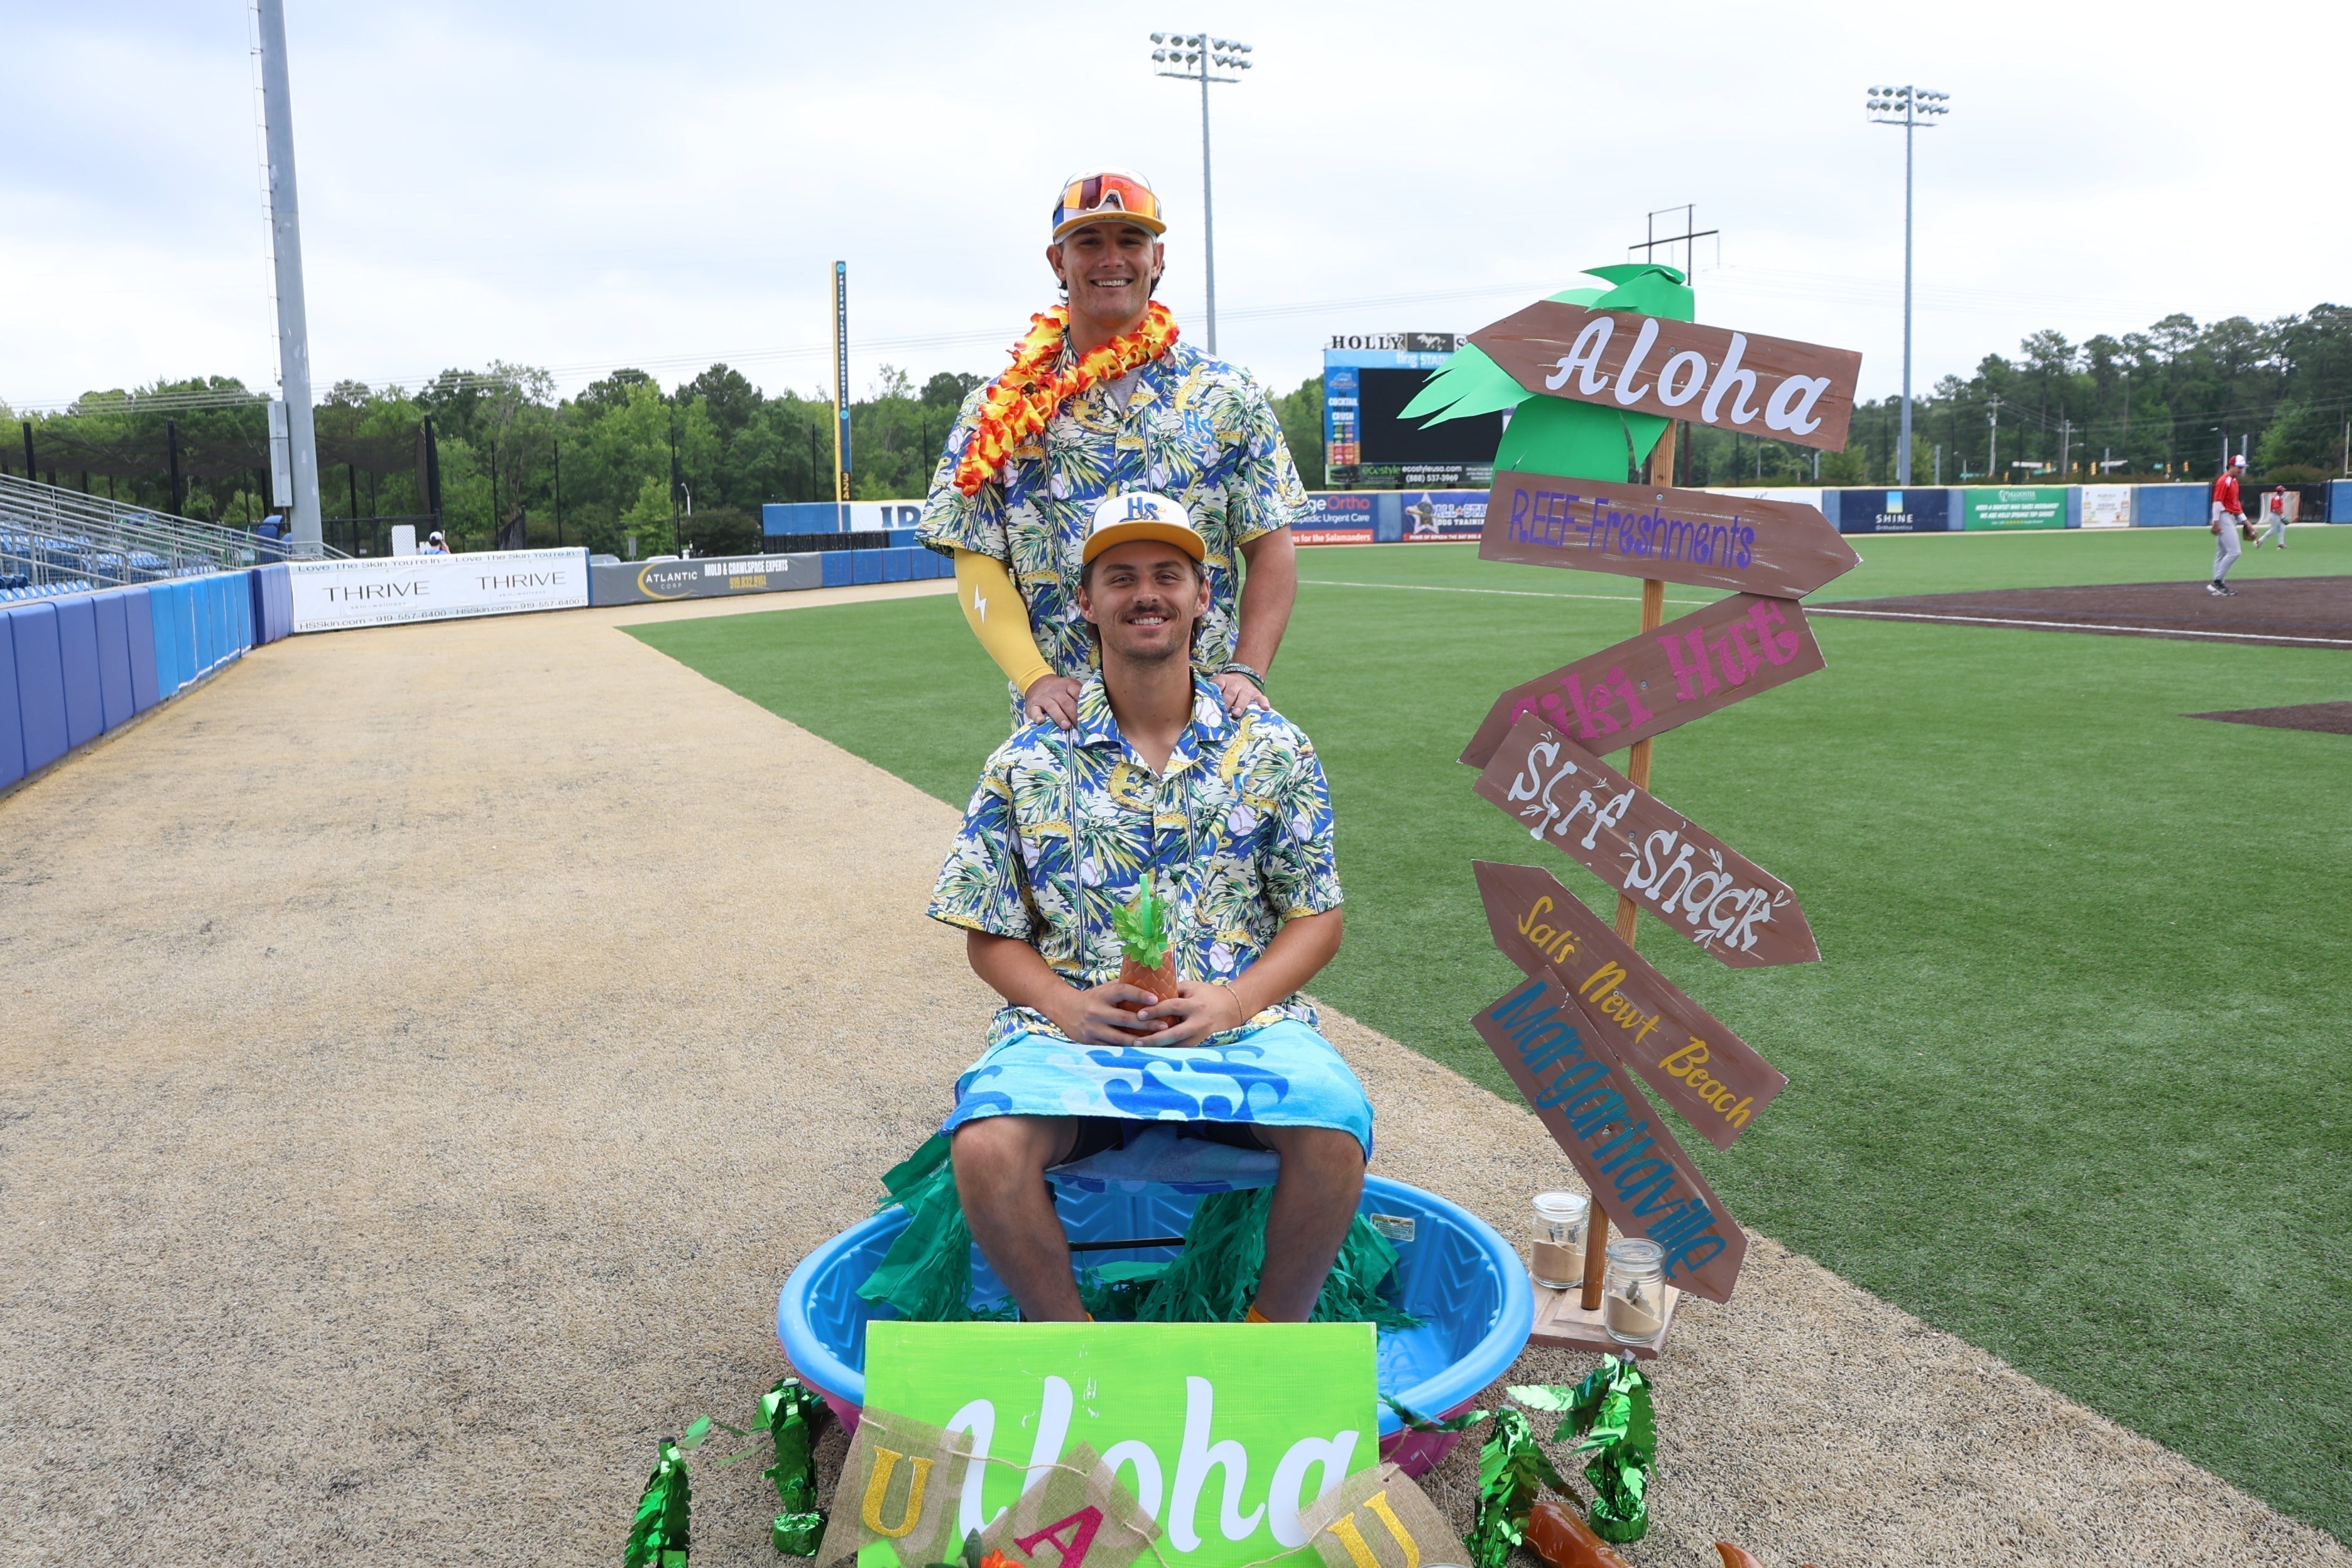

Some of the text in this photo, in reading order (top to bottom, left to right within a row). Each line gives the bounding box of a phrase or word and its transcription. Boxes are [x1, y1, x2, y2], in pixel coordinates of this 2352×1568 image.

[1331, 335, 1403, 349] HOLLY
[1396, 351, 1417, 368] ting
[1545, 316, 1832, 436] Aloha
[1328, 397, 1359, 406] COCKTAIL
[1332, 411, 1354, 421] CRUSH
[1402, 465, 1462, 474] ecostyleusa.com
[1405, 474, 1426, 483] (888)
[842, 472, 851, 500] 324
[1307, 495, 1370, 514] geOrtho
[880, 505, 922, 528] ID
[1322, 513, 1350, 525] Urgent
[1351, 513, 1370, 523] Care
[1875, 513, 1914, 524] SHINE
[1508, 487, 1755, 569] REEF-Freshments
[1300, 533, 1312, 543] for
[1312, 533, 1324, 543] the
[1325, 533, 1371, 543] Salamanders
[361, 560, 388, 569] Skin
[704, 558, 788, 577] MOLD & CRAWLSPACE EXPERTS
[475, 571, 566, 591] THRIVE
[646, 571, 698, 583] ATLANTIC
[322, 580, 430, 602] THRIVE
[300, 598, 580, 630] HSSkin.com 919-557-6400 HSSkin.com 919-557-6400
[1655, 599, 1800, 703] Hut
[1623, 829, 1772, 952] Shack
[1518, 895, 1755, 1130] Sal's Newt Beach
[1489, 980, 1727, 1279] Margaritaville
[898, 1375, 1359, 1554] Aloha
[873, 1444, 1420, 1568] U A U
